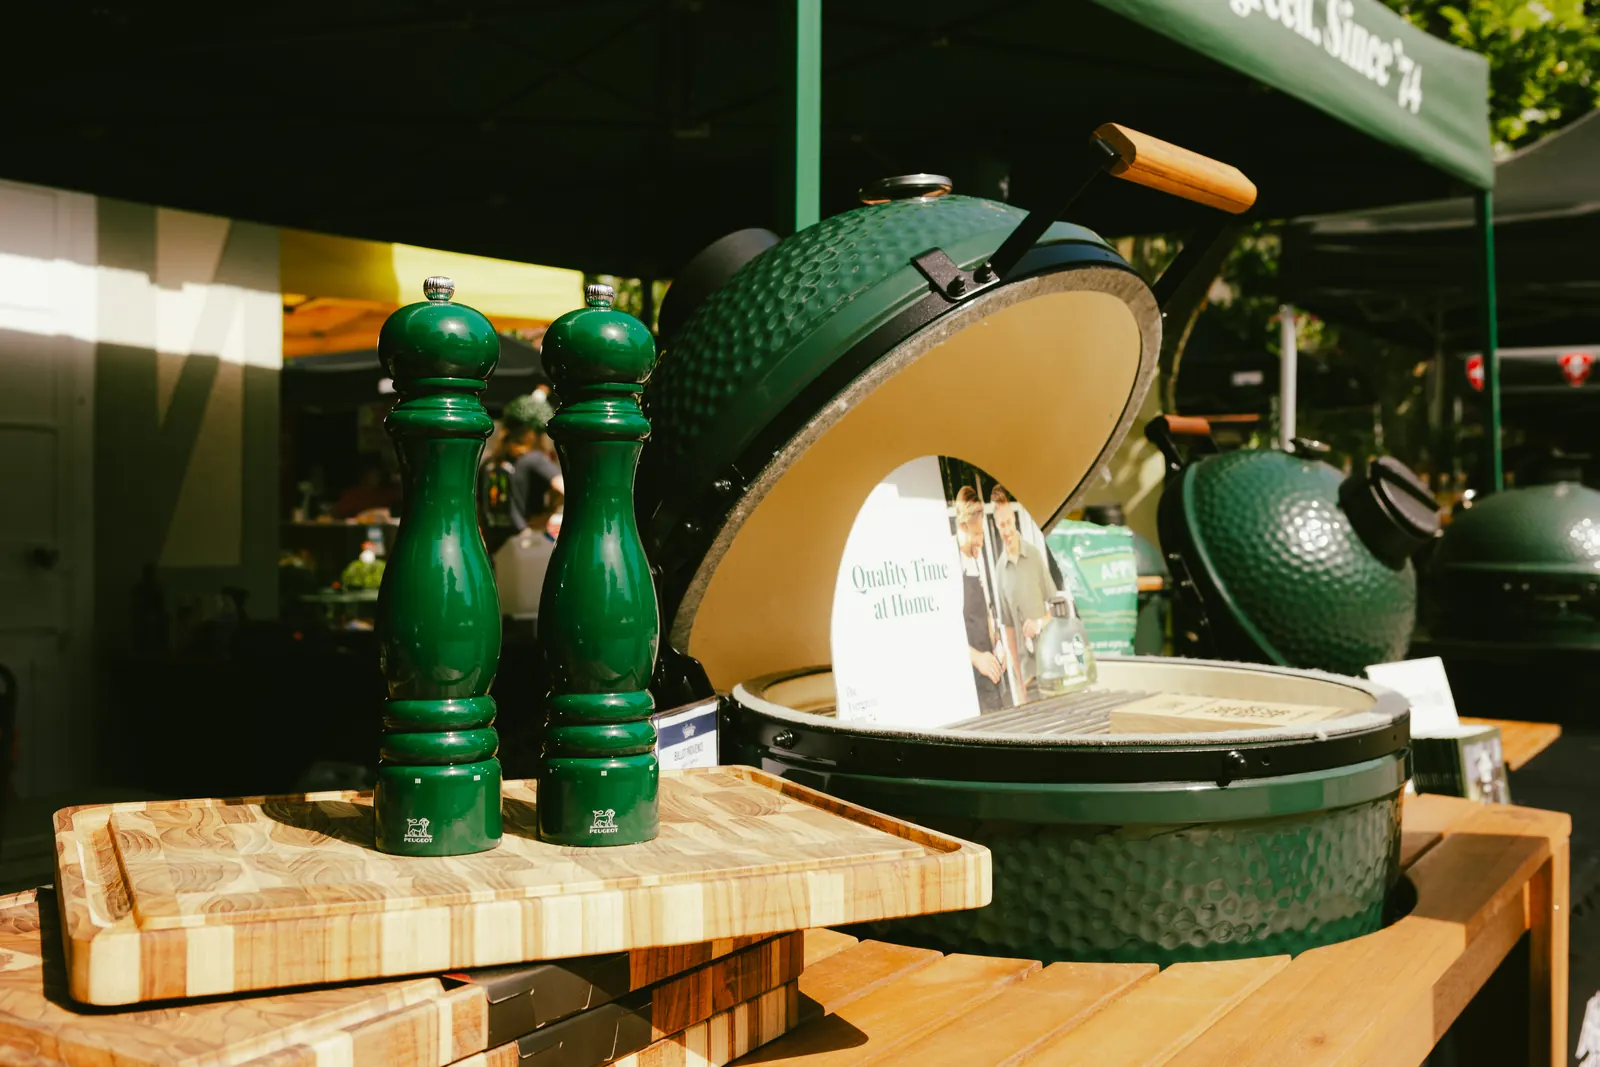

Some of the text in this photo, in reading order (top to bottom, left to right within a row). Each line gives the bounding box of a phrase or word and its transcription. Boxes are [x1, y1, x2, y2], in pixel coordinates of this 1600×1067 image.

[1229, 0, 1321, 46] een.
[1323, 0, 1393, 87] Since
[852, 558, 949, 595] Quality Time
[873, 594, 940, 620] at Home.
